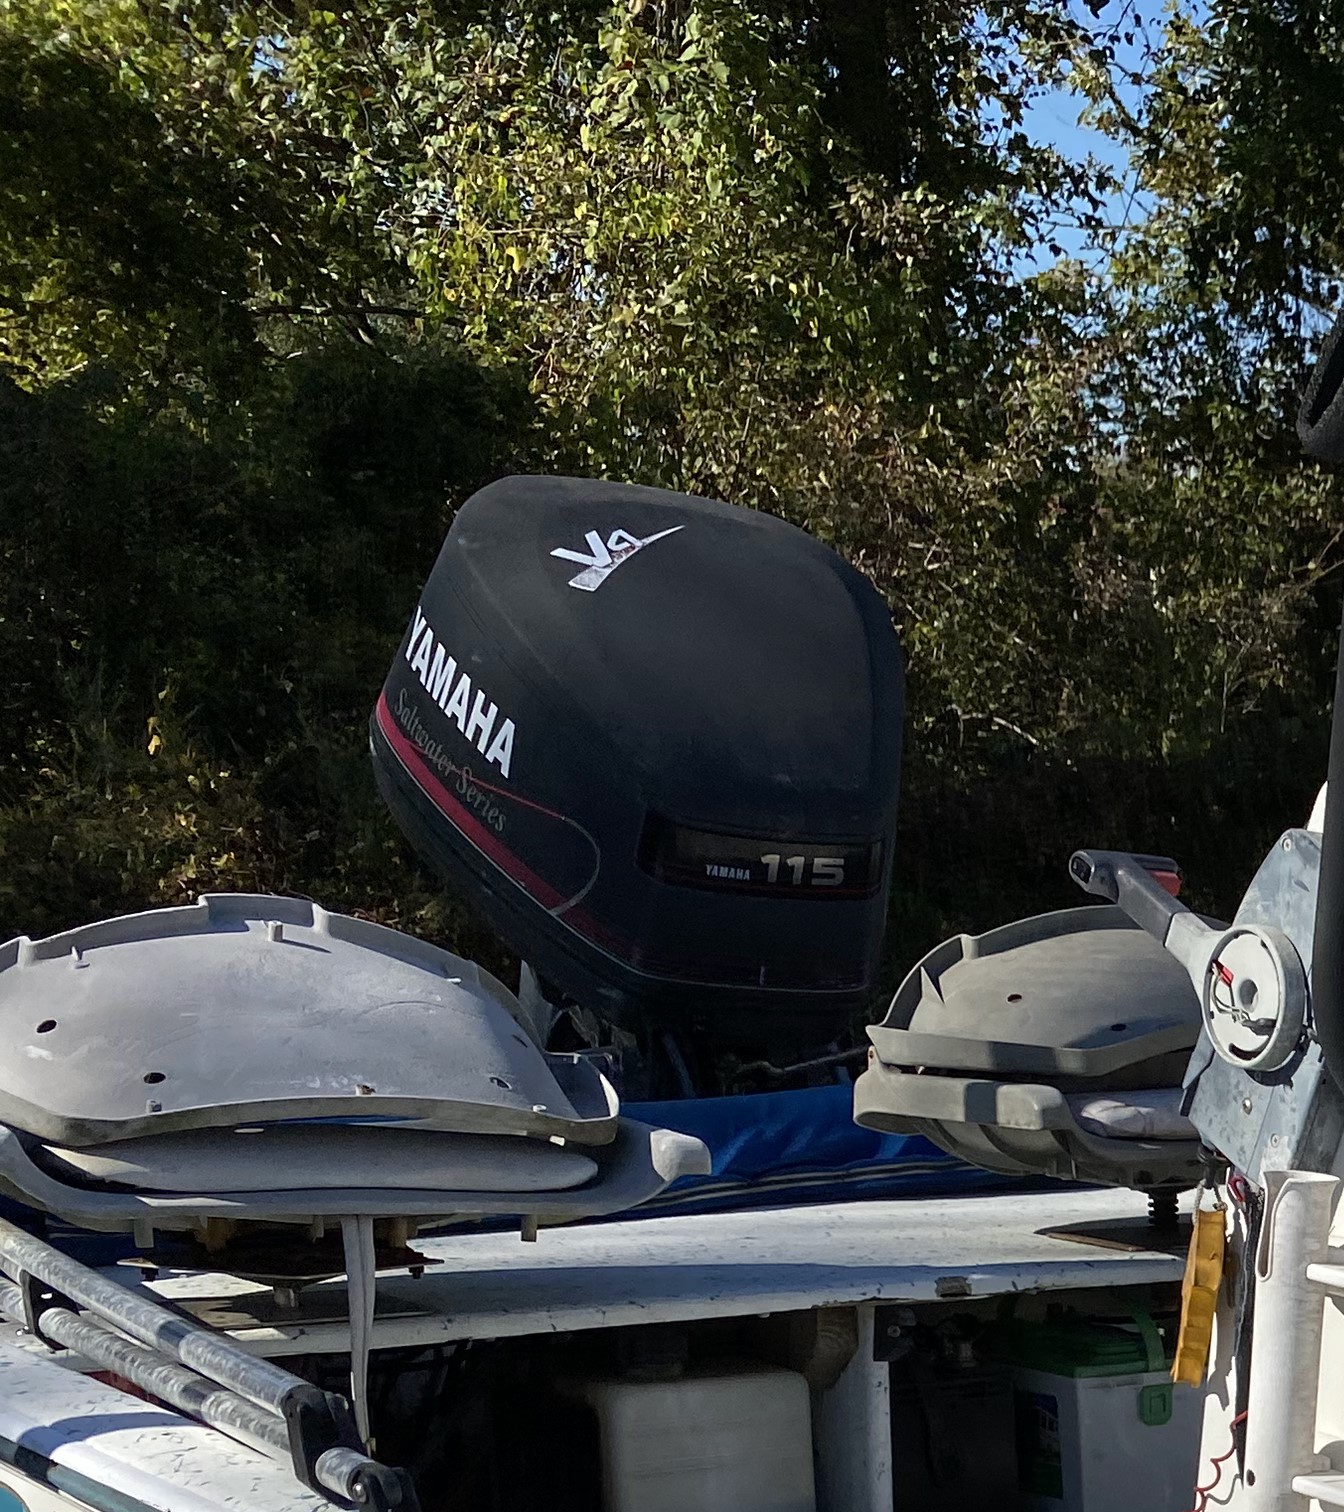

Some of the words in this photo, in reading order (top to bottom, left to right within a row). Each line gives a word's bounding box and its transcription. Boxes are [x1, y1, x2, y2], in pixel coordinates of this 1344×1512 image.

[405, 605, 516, 779] YAMAHA
[456, 766, 507, 832] Series
[706, 864, 751, 881] YAMAHA
[761, 853, 846, 887] 115
